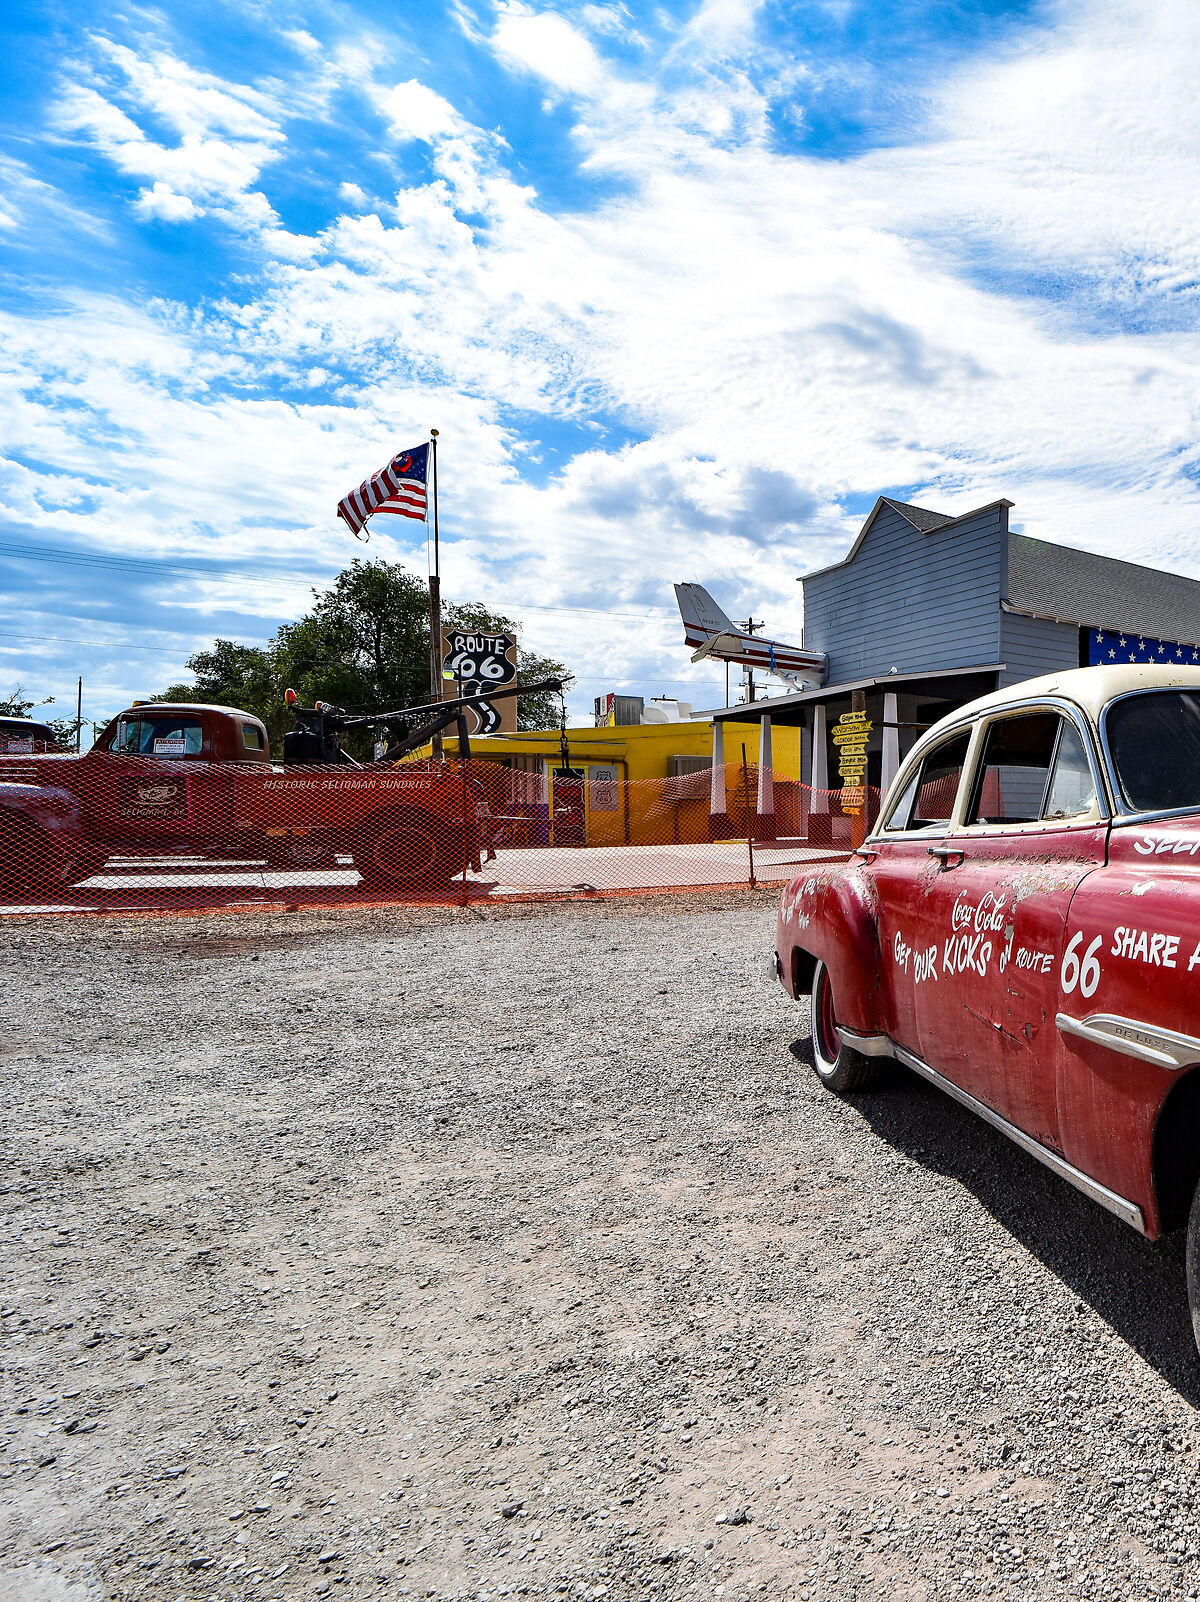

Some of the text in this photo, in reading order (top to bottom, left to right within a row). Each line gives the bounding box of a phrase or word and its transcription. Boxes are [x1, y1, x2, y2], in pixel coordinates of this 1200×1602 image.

[454, 635, 505, 655] ROUTE
[451, 651, 505, 679] 66
[263, 780, 432, 790] HISTORIC SELIGMAN SUNDRIES
[951, 889, 1008, 933] Coca-Cola
[894, 930, 912, 975] GET
[1015, 946, 1055, 974] ROUTE
[1060, 930, 1103, 998] 66
[1111, 925, 1178, 969] SHARE
